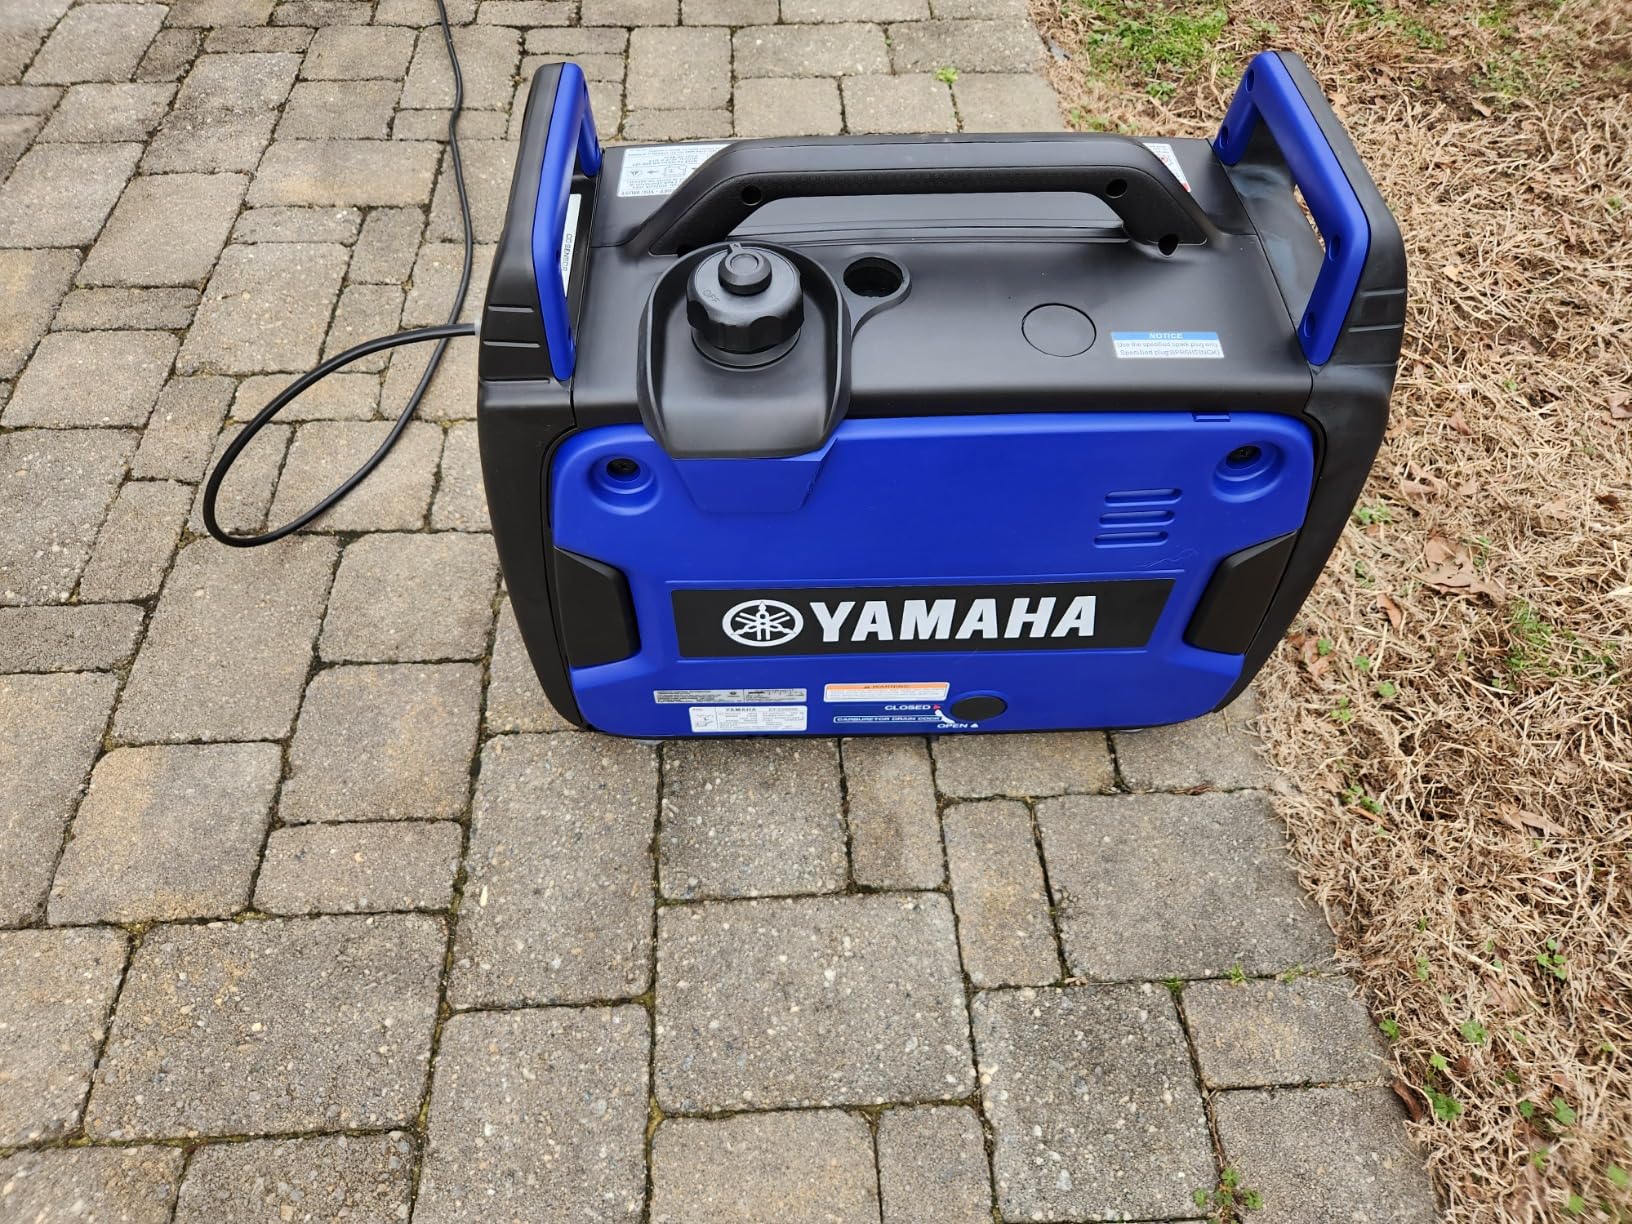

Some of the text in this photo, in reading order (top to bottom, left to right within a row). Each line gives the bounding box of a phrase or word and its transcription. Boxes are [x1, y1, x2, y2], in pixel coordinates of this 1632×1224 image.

[702, 289, 720, 303] OFF
[1148, 332, 1185, 340] NOTICE
[810, 596, 1097, 642] YAMAHA
